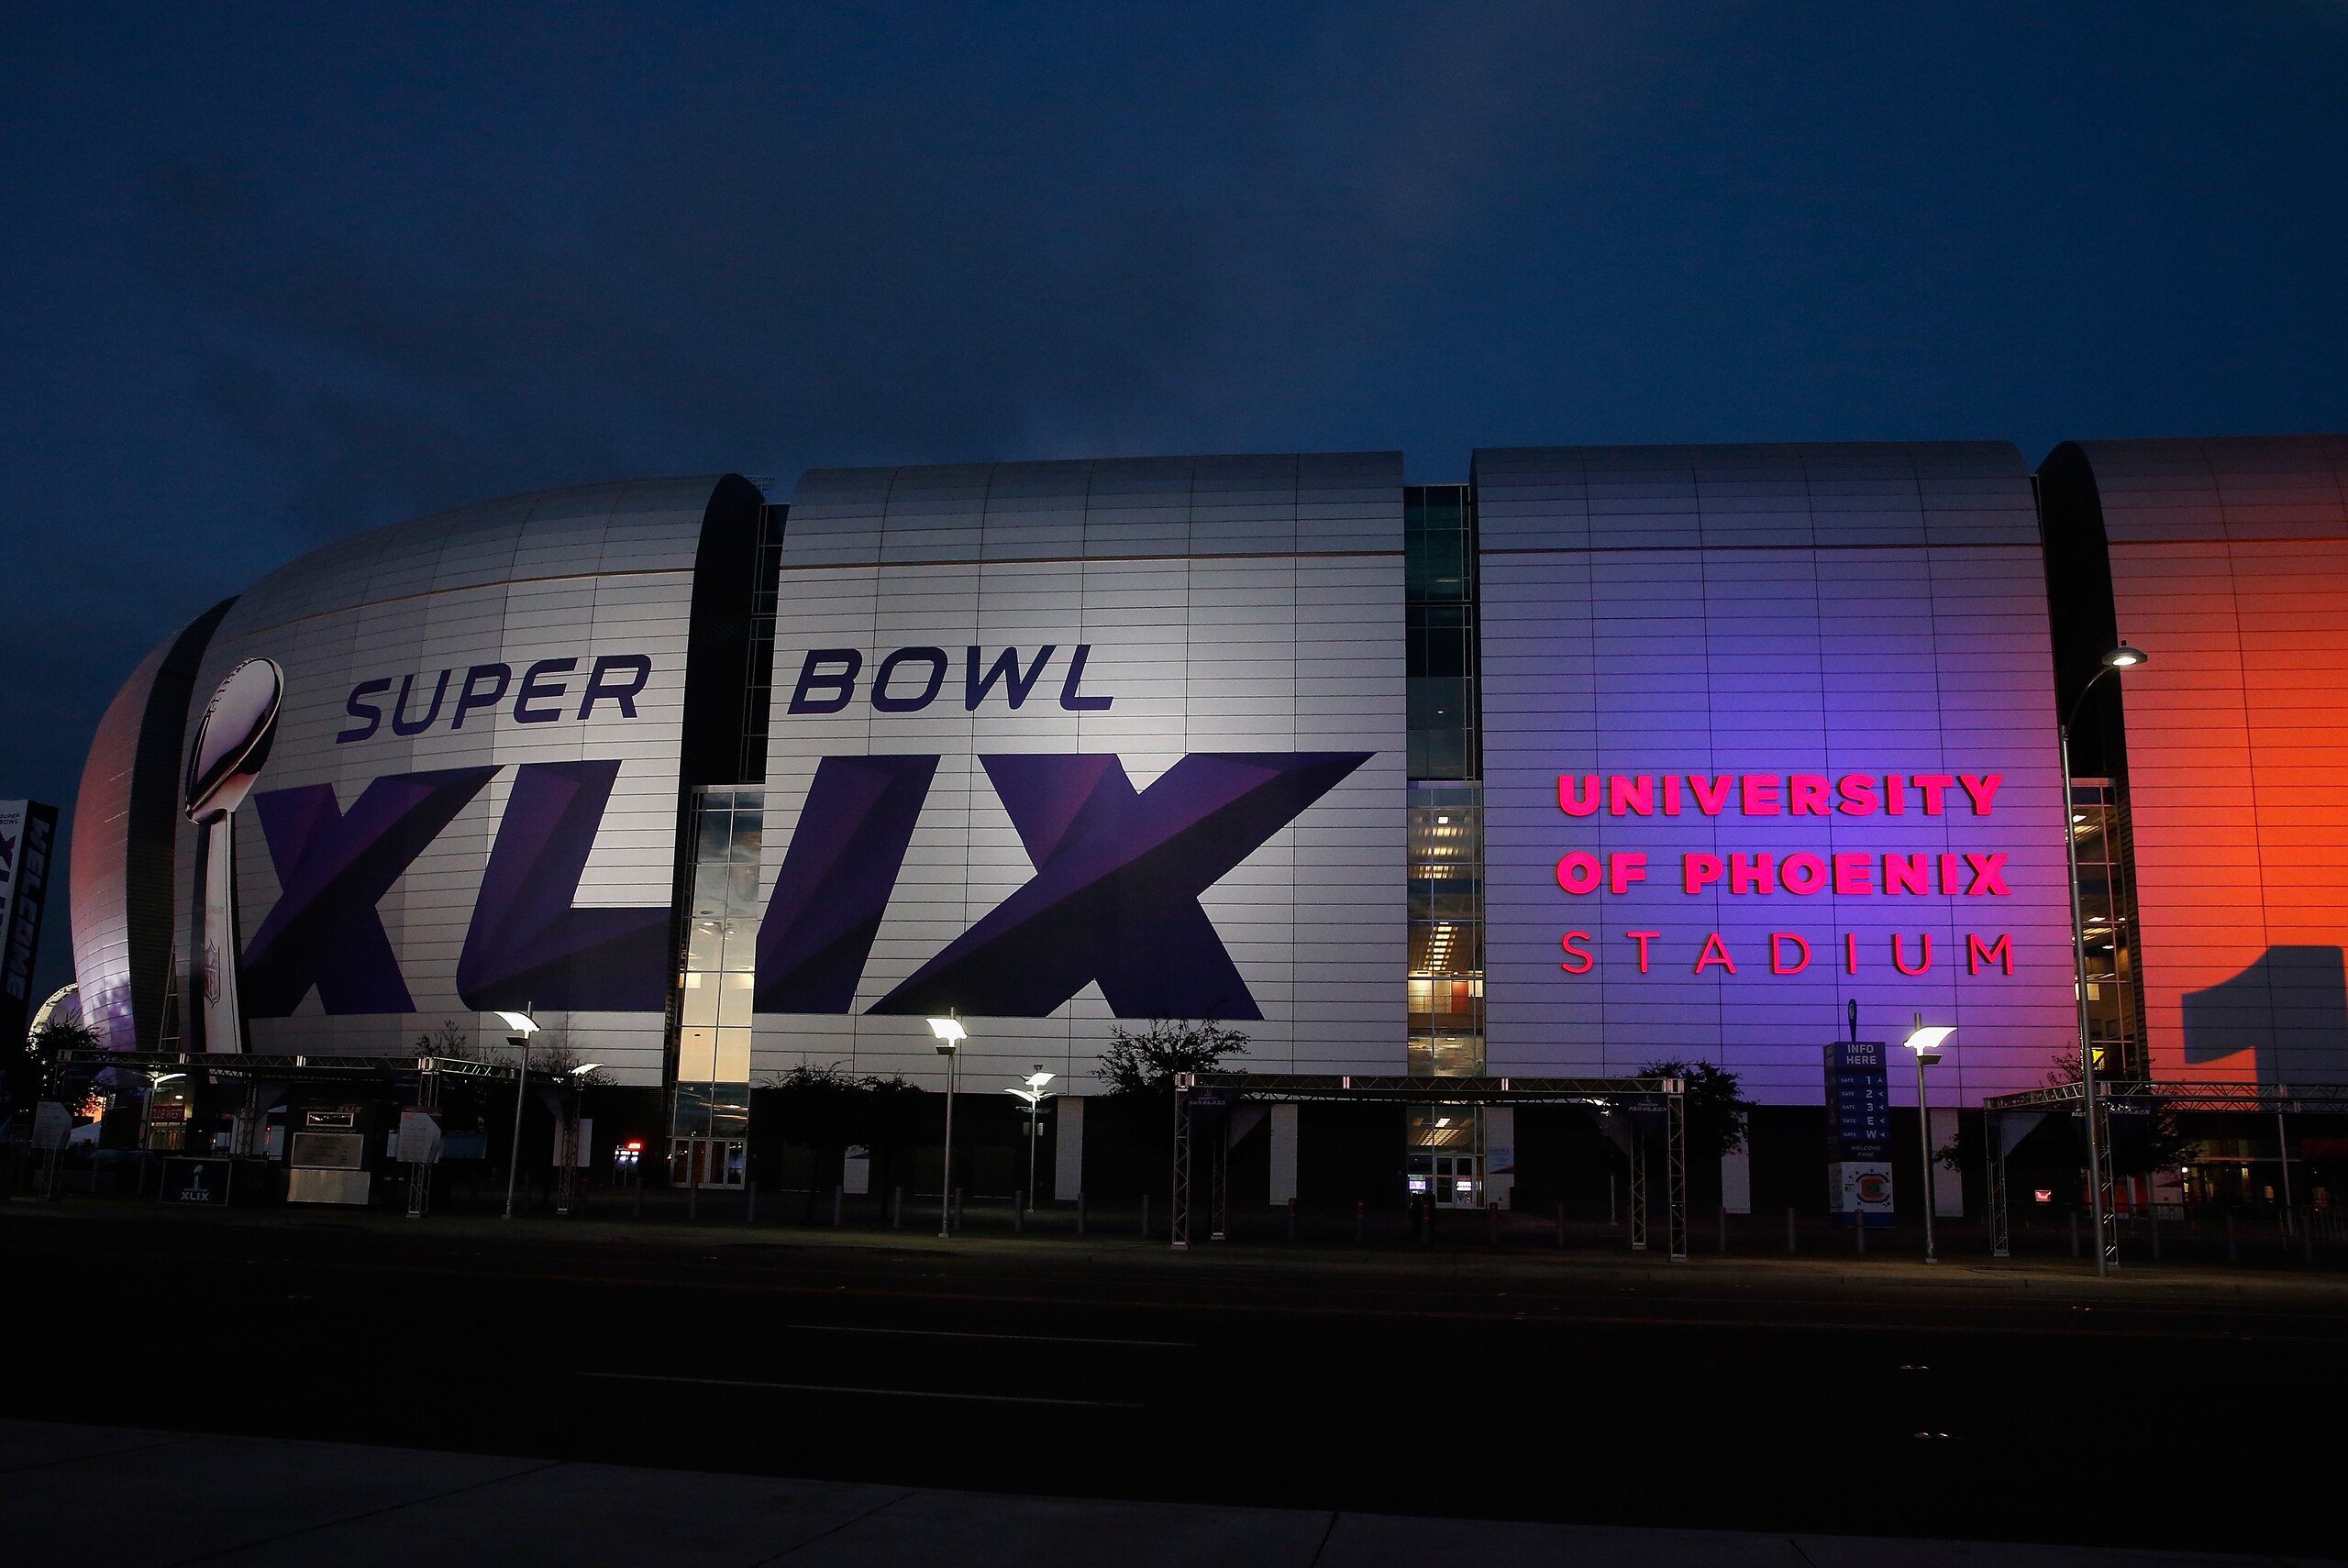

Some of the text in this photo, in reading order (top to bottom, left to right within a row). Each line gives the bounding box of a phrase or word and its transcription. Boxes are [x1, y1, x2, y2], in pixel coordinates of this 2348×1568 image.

[336, 644, 1113, 744] SUPER BOWL
[1557, 774, 2005, 817] UNIVERSITY
[1556, 852, 2010, 896] OF PHOENIX
[240, 751, 1377, 1020] XLIX
[6, 814, 50, 1000] WELCOME
[1561, 931, 2015, 976] STADIUM
[1847, 1044, 1874, 1054] INFO
[1846, 1055, 1877, 1065] HERE
[1866, 1076, 1871, 1085] 1
[1866, 1089, 1873, 1099] 2
[1866, 1103, 1874, 1112] 3
[1866, 1116, 1875, 1126] E
[1866, 1130, 1877, 1140] W
[181, 1191, 210, 1201] XLIX
